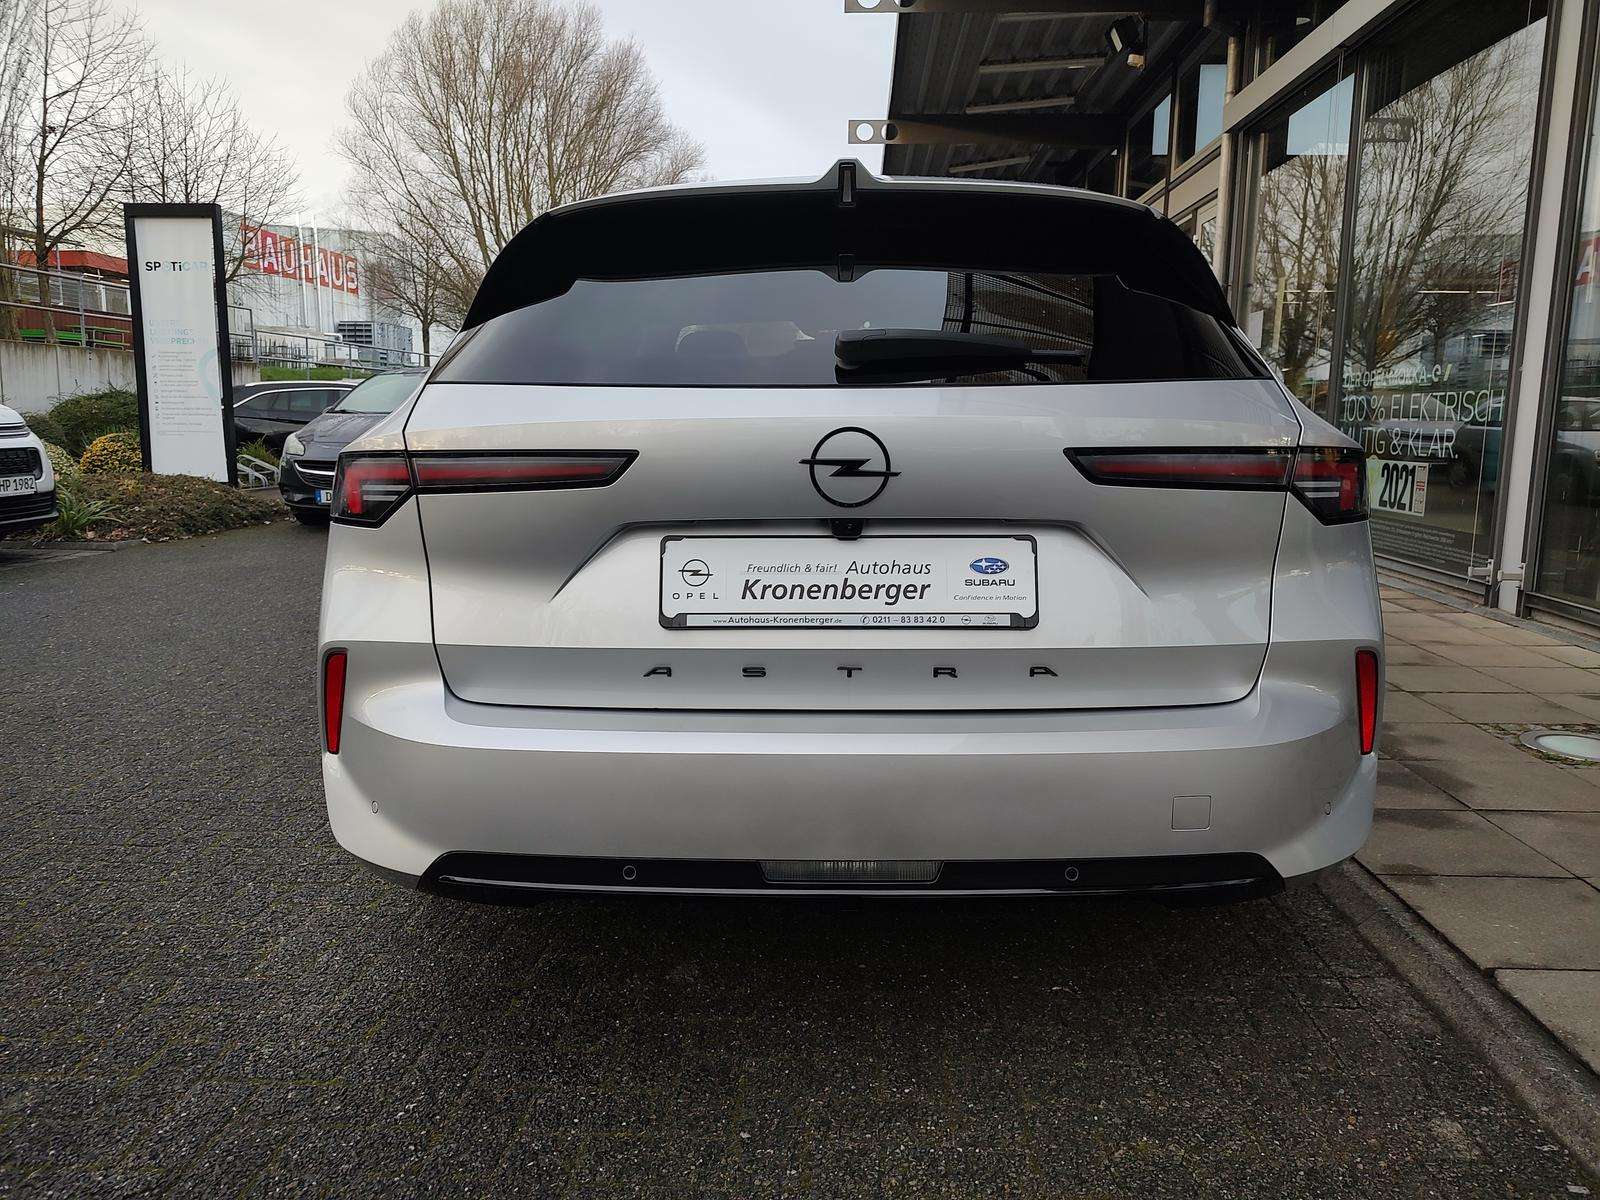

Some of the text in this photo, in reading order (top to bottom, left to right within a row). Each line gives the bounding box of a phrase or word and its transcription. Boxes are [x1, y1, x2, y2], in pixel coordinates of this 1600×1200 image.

[1390, 390, 1505, 422] ELEKTRISCH
[13, 477, 35, 491] 1982
[1378, 462, 1417, 512] 2021
[746, 560, 932, 575] Freundlich & fair! Autohaus
[964, 579, 1016, 587] SUBARU
[672, 592, 719, 600] OPEL
[741, 577, 931, 606] Kronenberger
[872, 615, 891, 624] 0211
[900, 615, 911, 624] 83
[913, 615, 924, 624] 83
[926, 615, 938, 624] 42
[643, 666, 1059, 678] ASTRA
